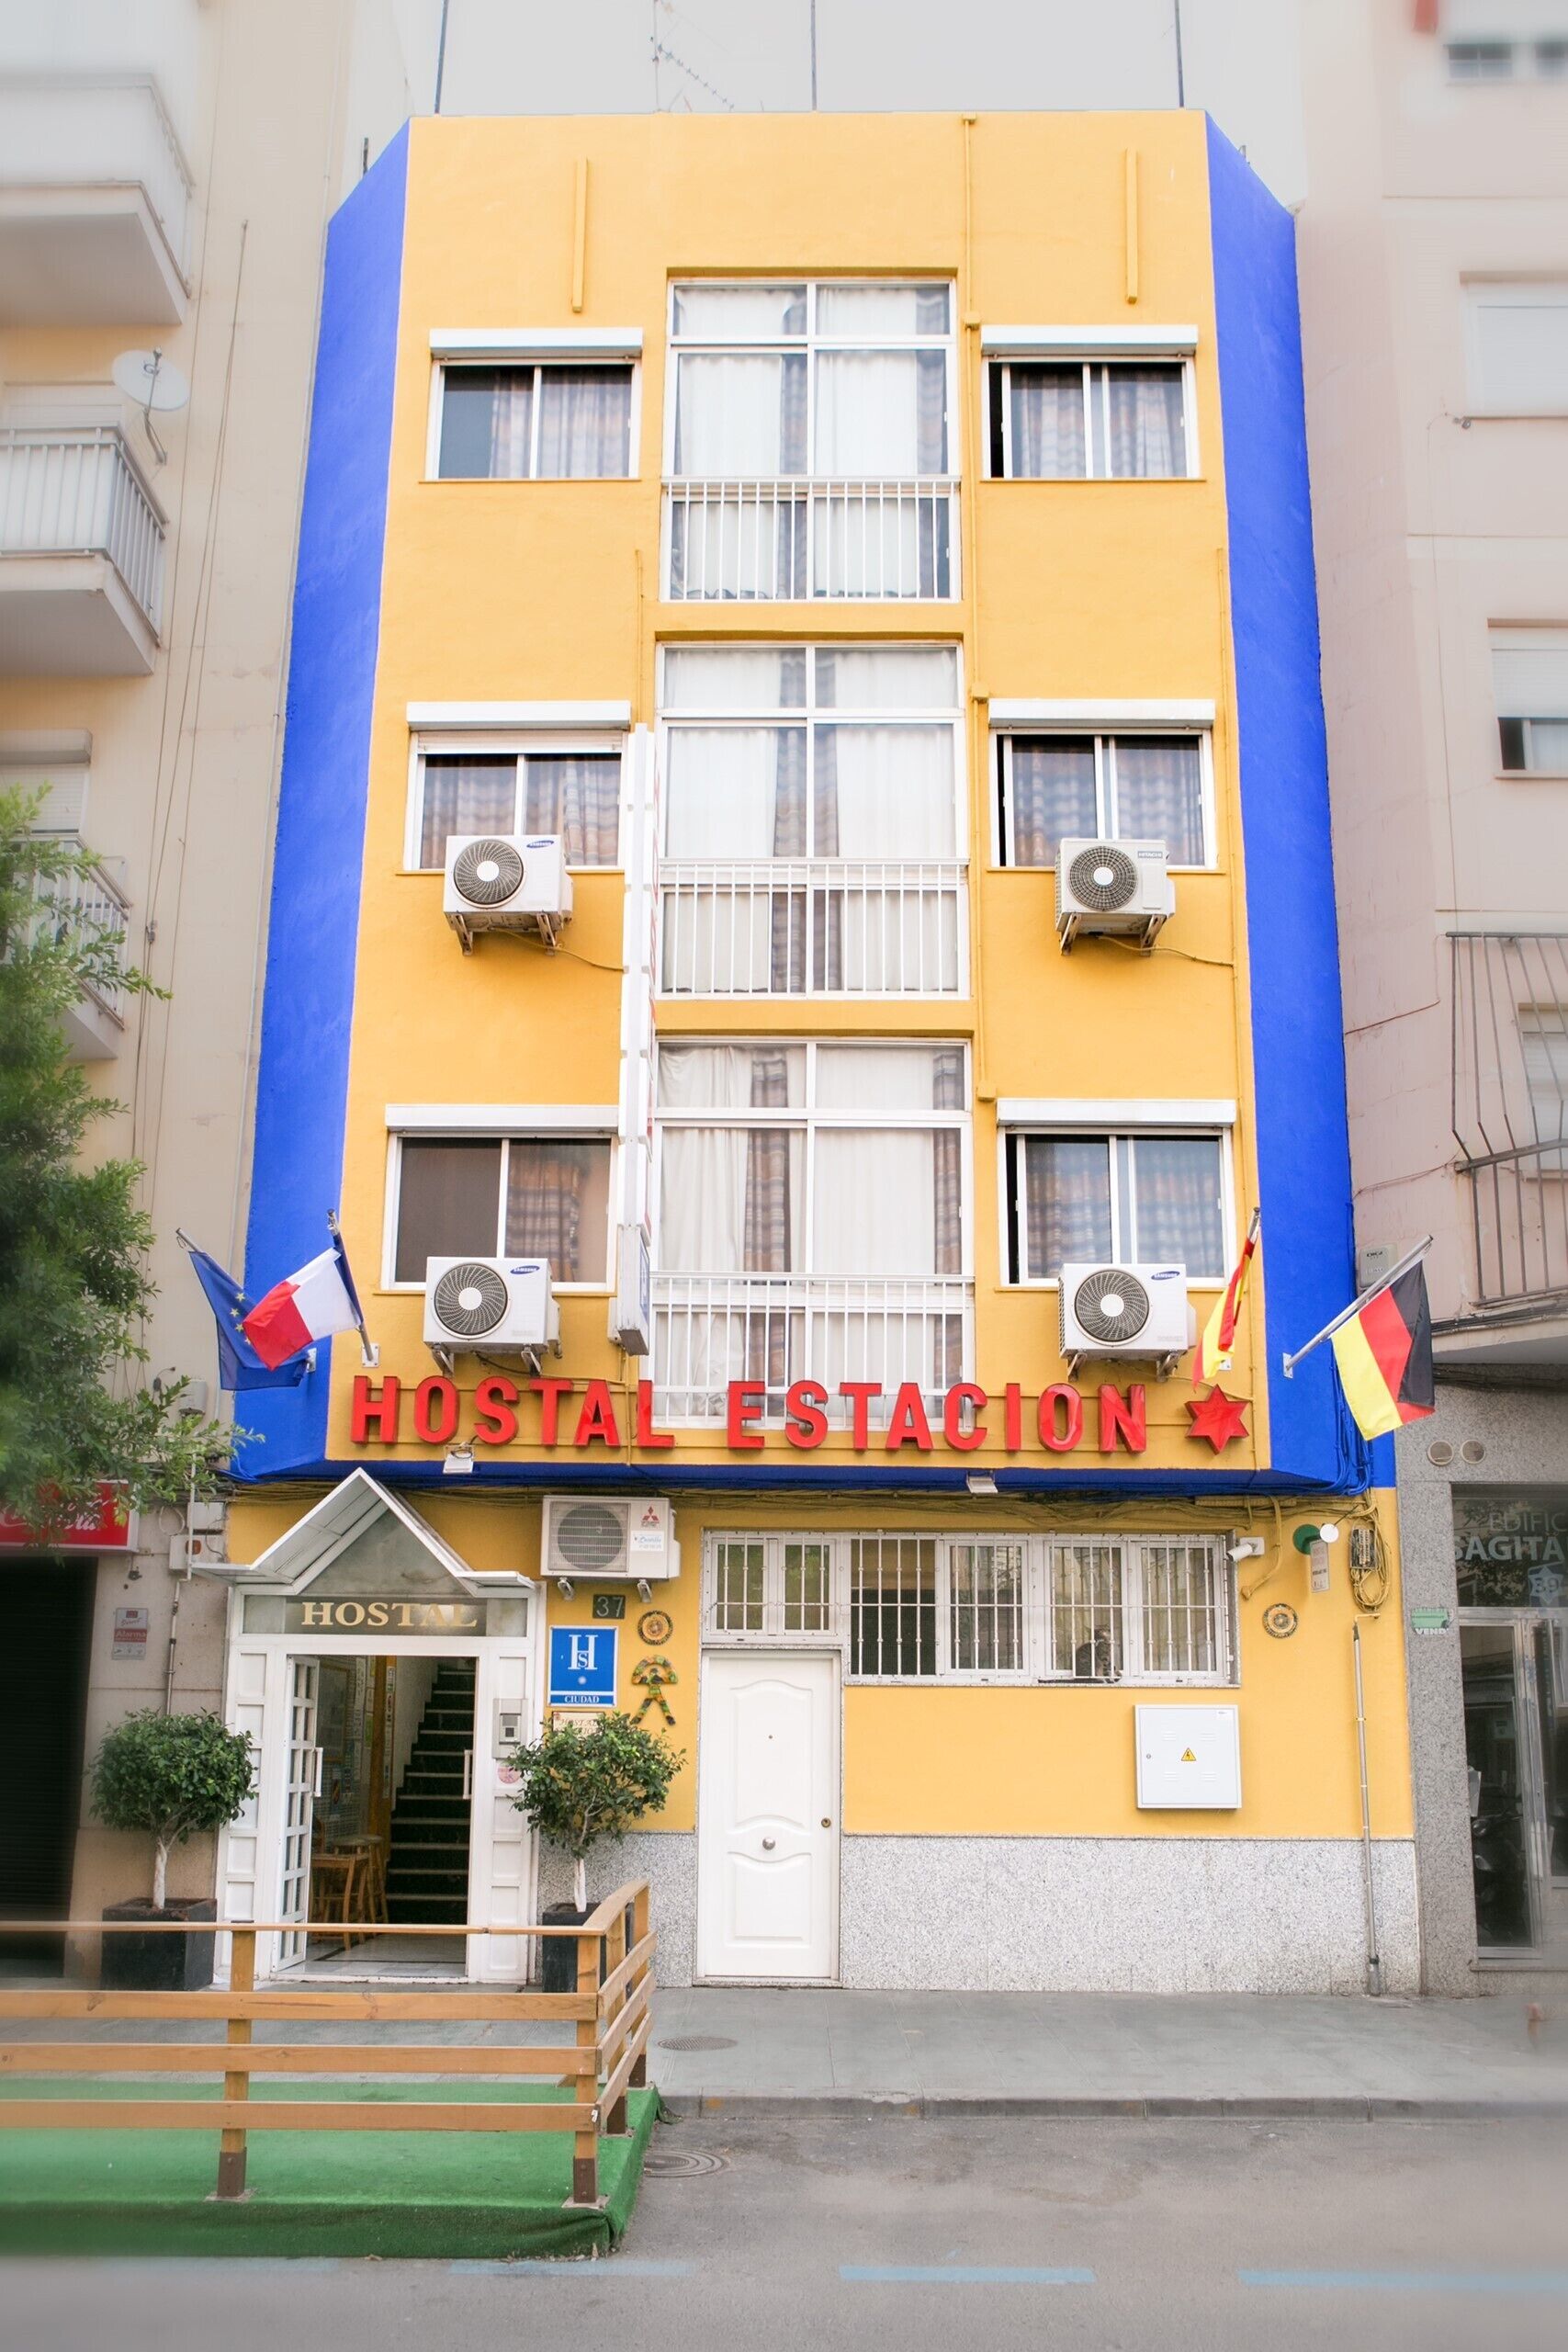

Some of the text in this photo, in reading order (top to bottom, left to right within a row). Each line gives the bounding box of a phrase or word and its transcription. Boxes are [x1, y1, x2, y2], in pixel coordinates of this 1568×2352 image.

[350, 1374, 1147, 1454] HOSTAL ESTACION
[301, 1601, 478, 1627] HOSTAL
[596, 1596, 624, 1618] 37
[564, 1695, 600, 1703] CIUDAD
